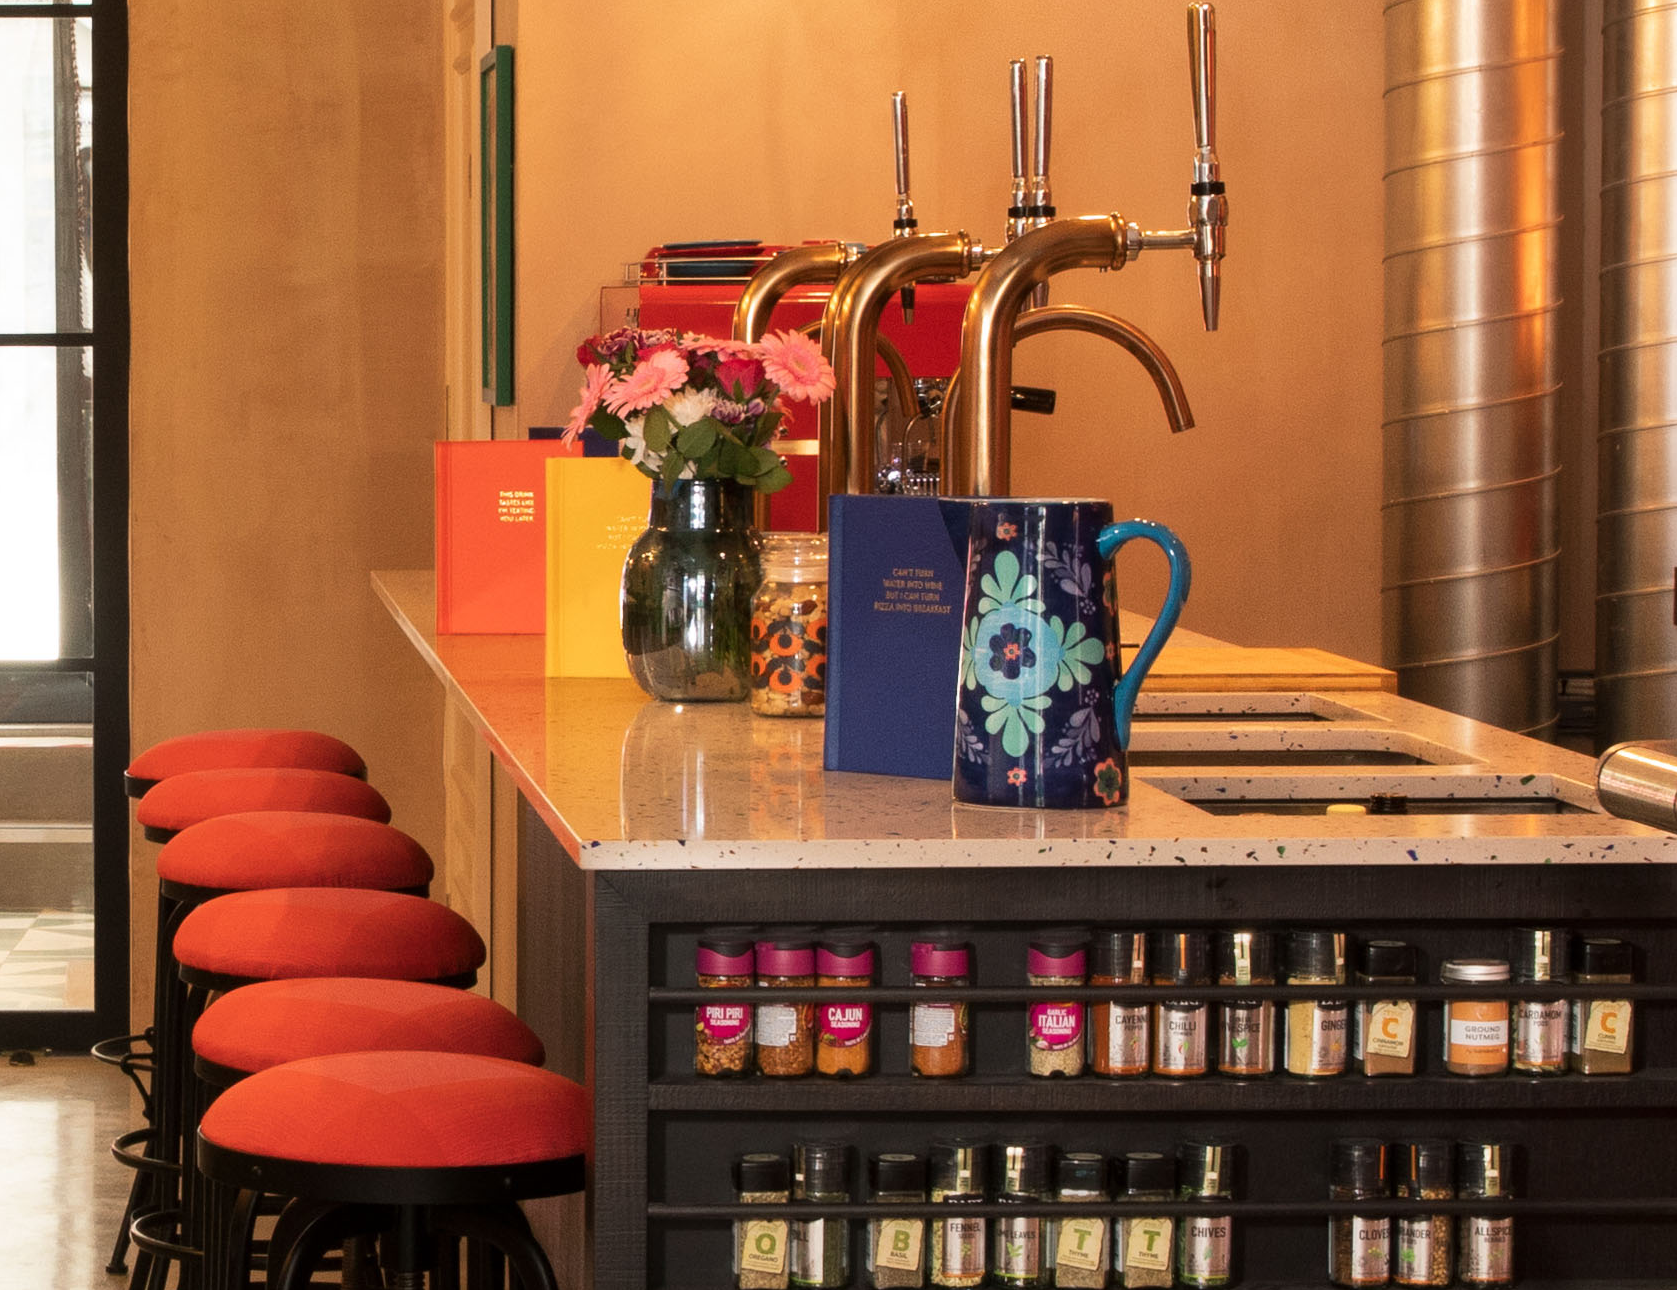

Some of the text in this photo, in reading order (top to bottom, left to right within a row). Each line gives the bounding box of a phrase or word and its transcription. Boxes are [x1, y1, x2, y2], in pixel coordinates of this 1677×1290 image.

[706, 1006, 743, 1019] PIRI PIRI
[828, 1008, 863, 1022] CAJUN
[1519, 1009, 1562, 1021] CARDAMOM
[1038, 1014, 1076, 1028] ITALIAN
[1169, 1021, 1197, 1032] CHILLI
[1600, 1011, 1618, 1034] C
[1381, 1017, 1399, 1040] C
[1465, 1025, 1500, 1033] GROUND
[1465, 1033, 1500, 1041] NUTMEG
[950, 1222, 981, 1233] FENNEL
[1190, 1225, 1227, 1238] CHIVES
[893, 1230, 911, 1252] B
[1073, 1228, 1092, 1251] T
[1143, 1230, 1161, 1252] T
[748, 1253, 779, 1263] OREGANO
[890, 1251, 908, 1259] BASIL
[1068, 1249, 1090, 1259] THYME
